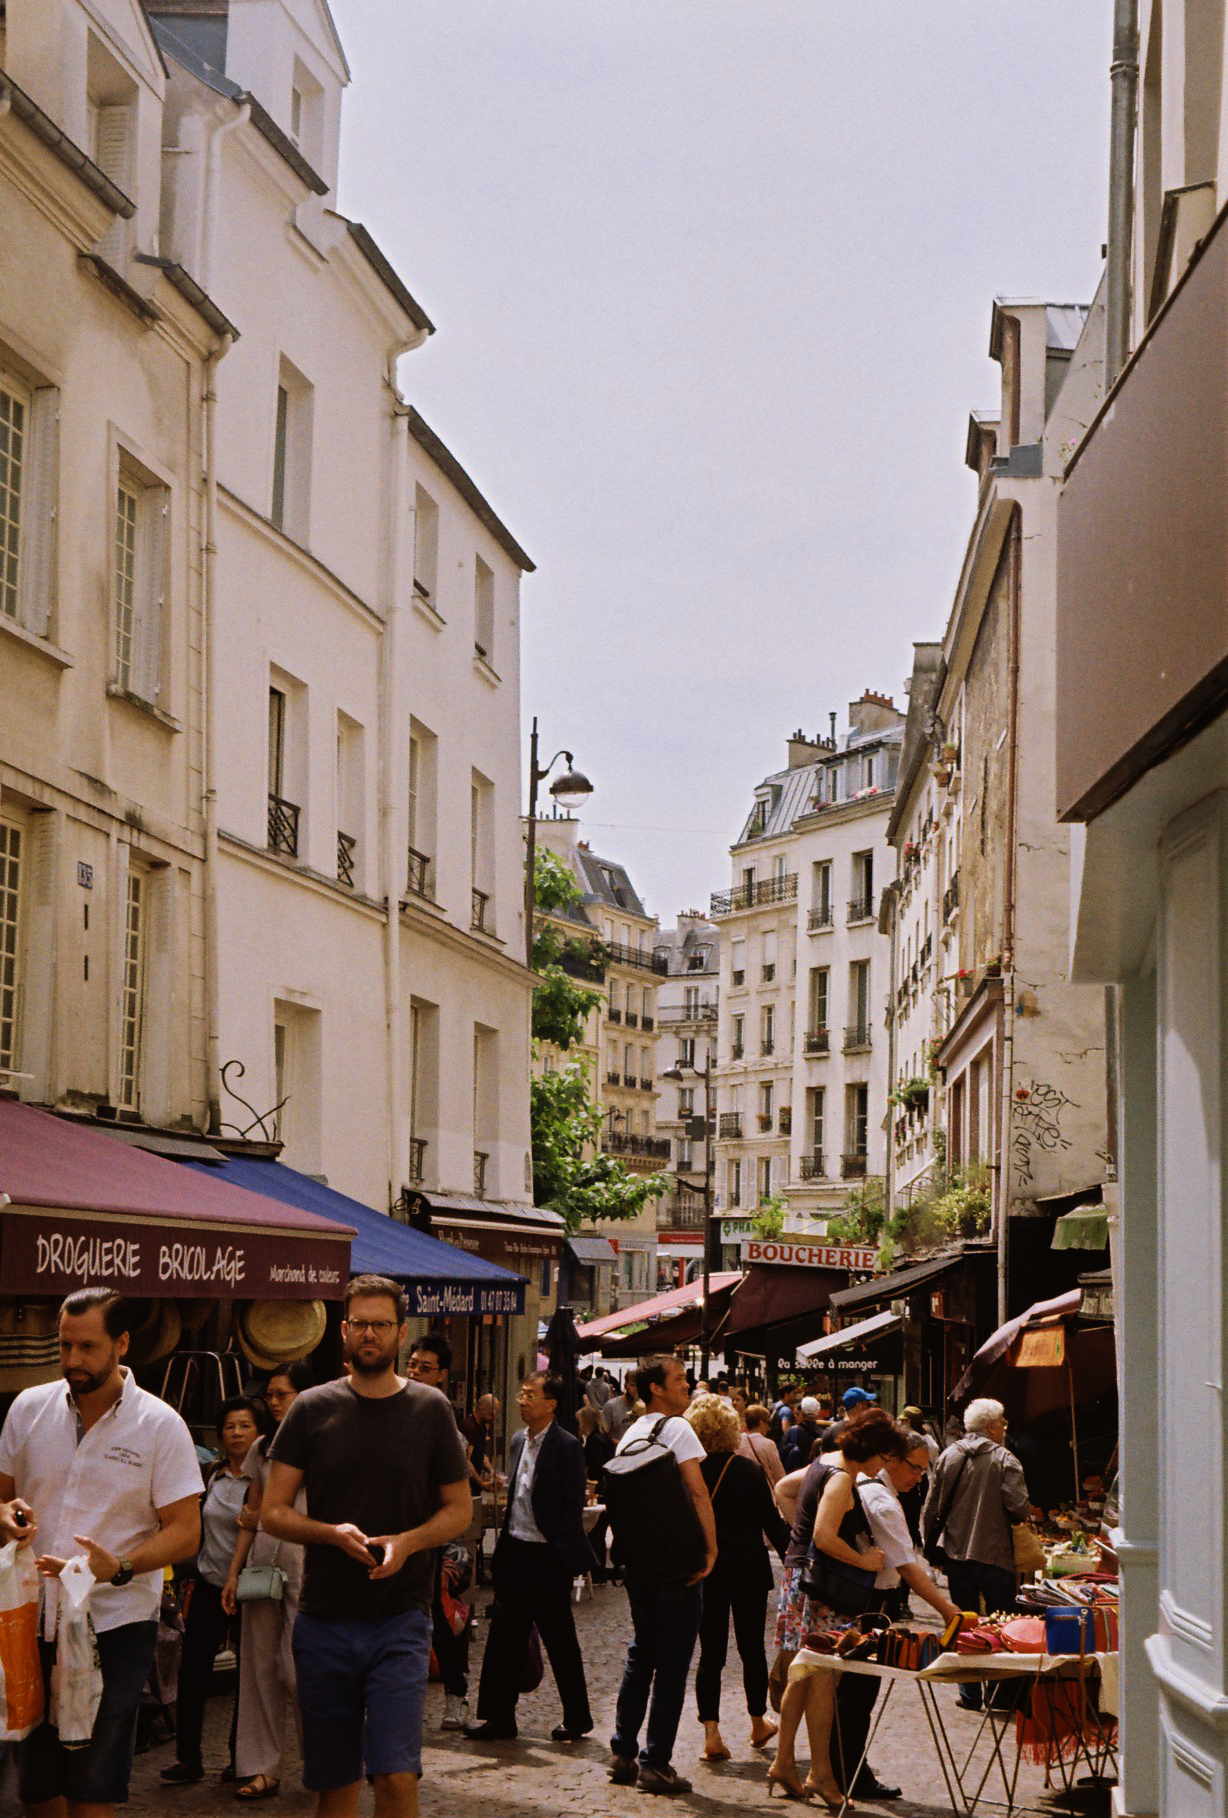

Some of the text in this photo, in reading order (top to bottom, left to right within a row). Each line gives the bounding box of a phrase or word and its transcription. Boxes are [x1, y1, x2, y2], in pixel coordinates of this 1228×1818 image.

[36, 1233, 246, 1289] DROGUERIE BRICOLAGE
[748, 1243, 876, 1270] BOUCHERIE
[308, 1264, 317, 1283] de
[416, 1285, 474, 1313] Saint-Médard
[777, 1358, 791, 1369] la
[828, 1358, 835, 1369] à
[838, 1360, 879, 1372] manger
